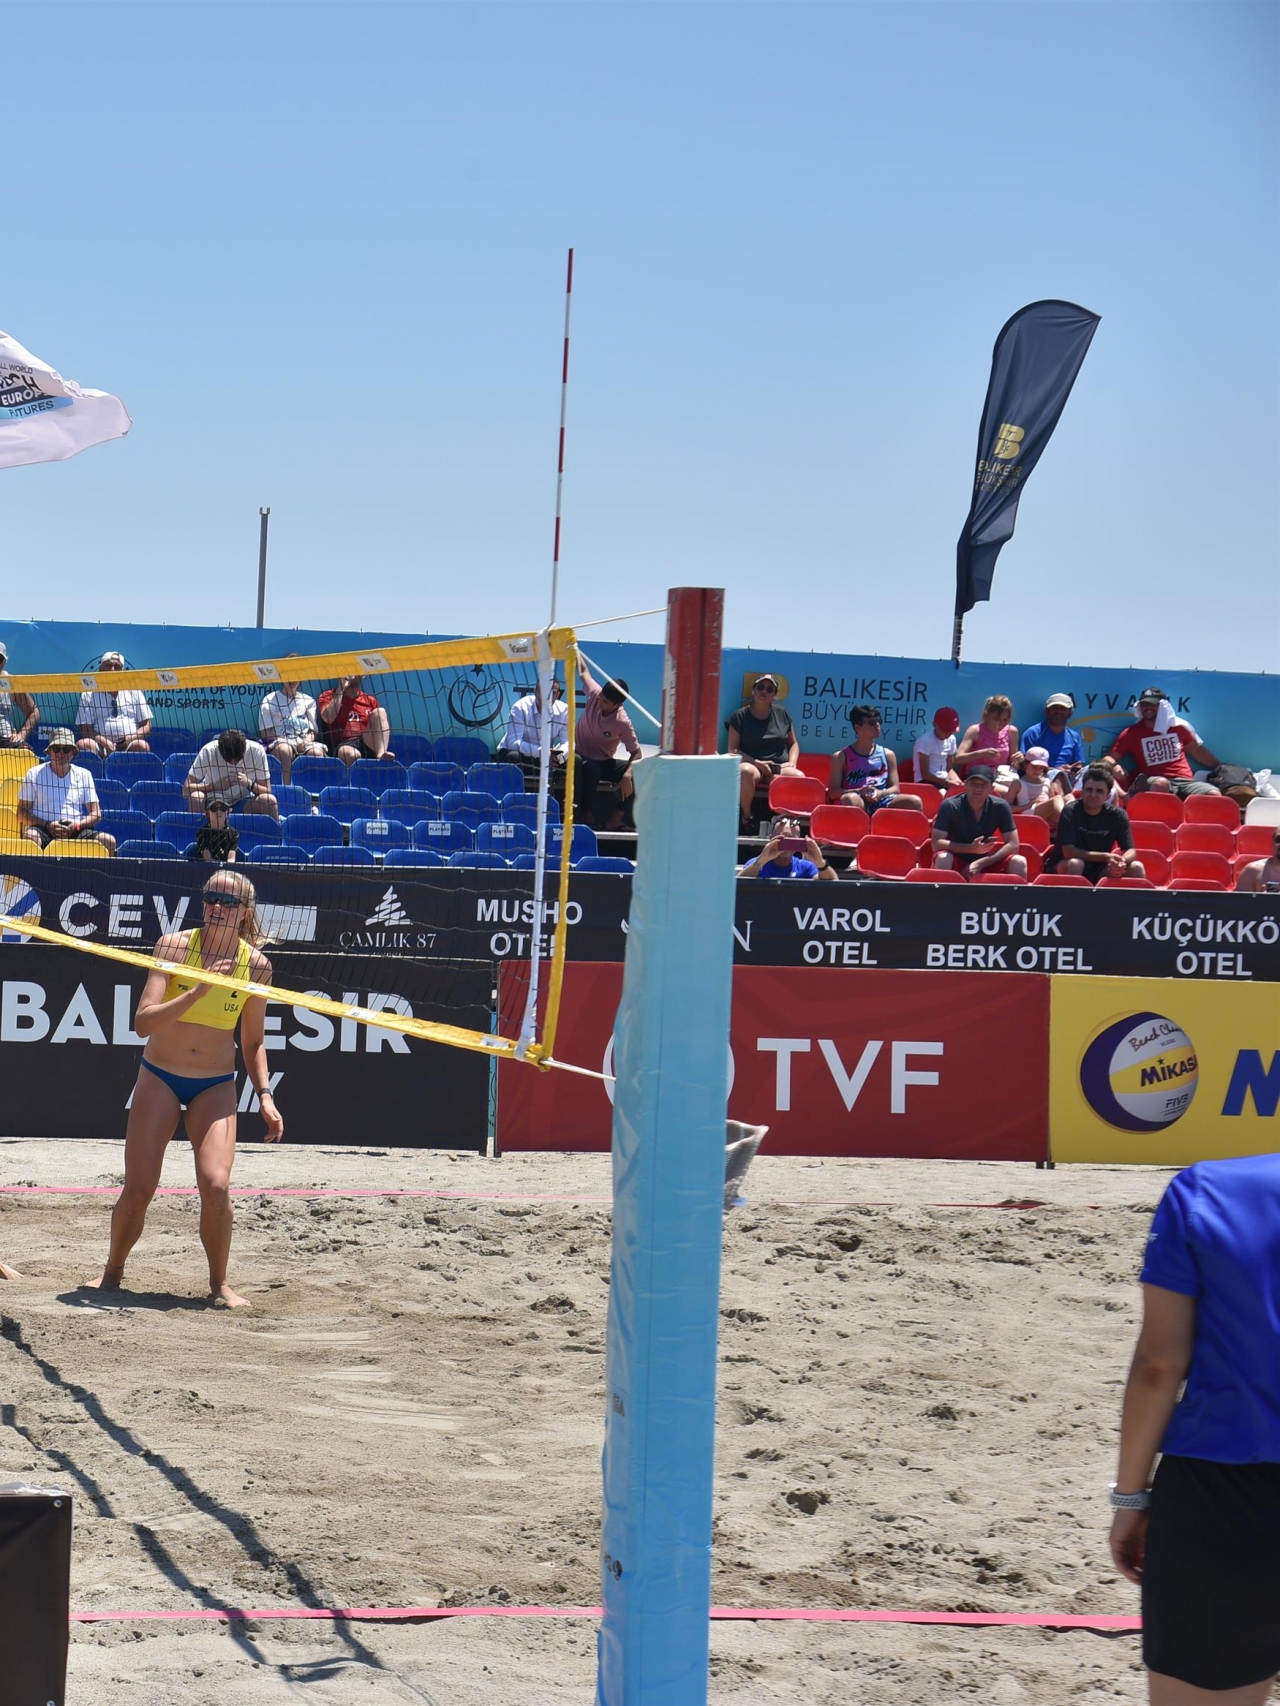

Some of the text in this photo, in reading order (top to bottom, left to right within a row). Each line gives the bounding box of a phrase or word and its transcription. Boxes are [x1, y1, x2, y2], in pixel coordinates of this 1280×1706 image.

[8, 363, 34, 374] WORLD
[210, 686, 227, 695] OF
[804, 676, 928, 702] BALIKESİR
[147, 697, 225, 709] AND SPORTS
[802, 700, 927, 726] BÜYÜEHİR
[59, 892, 191, 938] CEV
[476, 898, 583, 925] MUSHO
[793, 907, 891, 933] VAROL
[960, 906, 1063, 937] BÜYÜK
[339, 931, 437, 949] ÇAMLIK 87
[1131, 911, 1280, 947] KÜÇÜKKÖ
[802, 940, 878, 965] OTEL
[926, 943, 1093, 972] BERK OTEL
[1176, 951, 1253, 976] OTEL
[223, 1002, 239, 1013] USA
[1128, 1027, 1161, 1052] Beach
[757, 1037, 945, 1114] TVF
